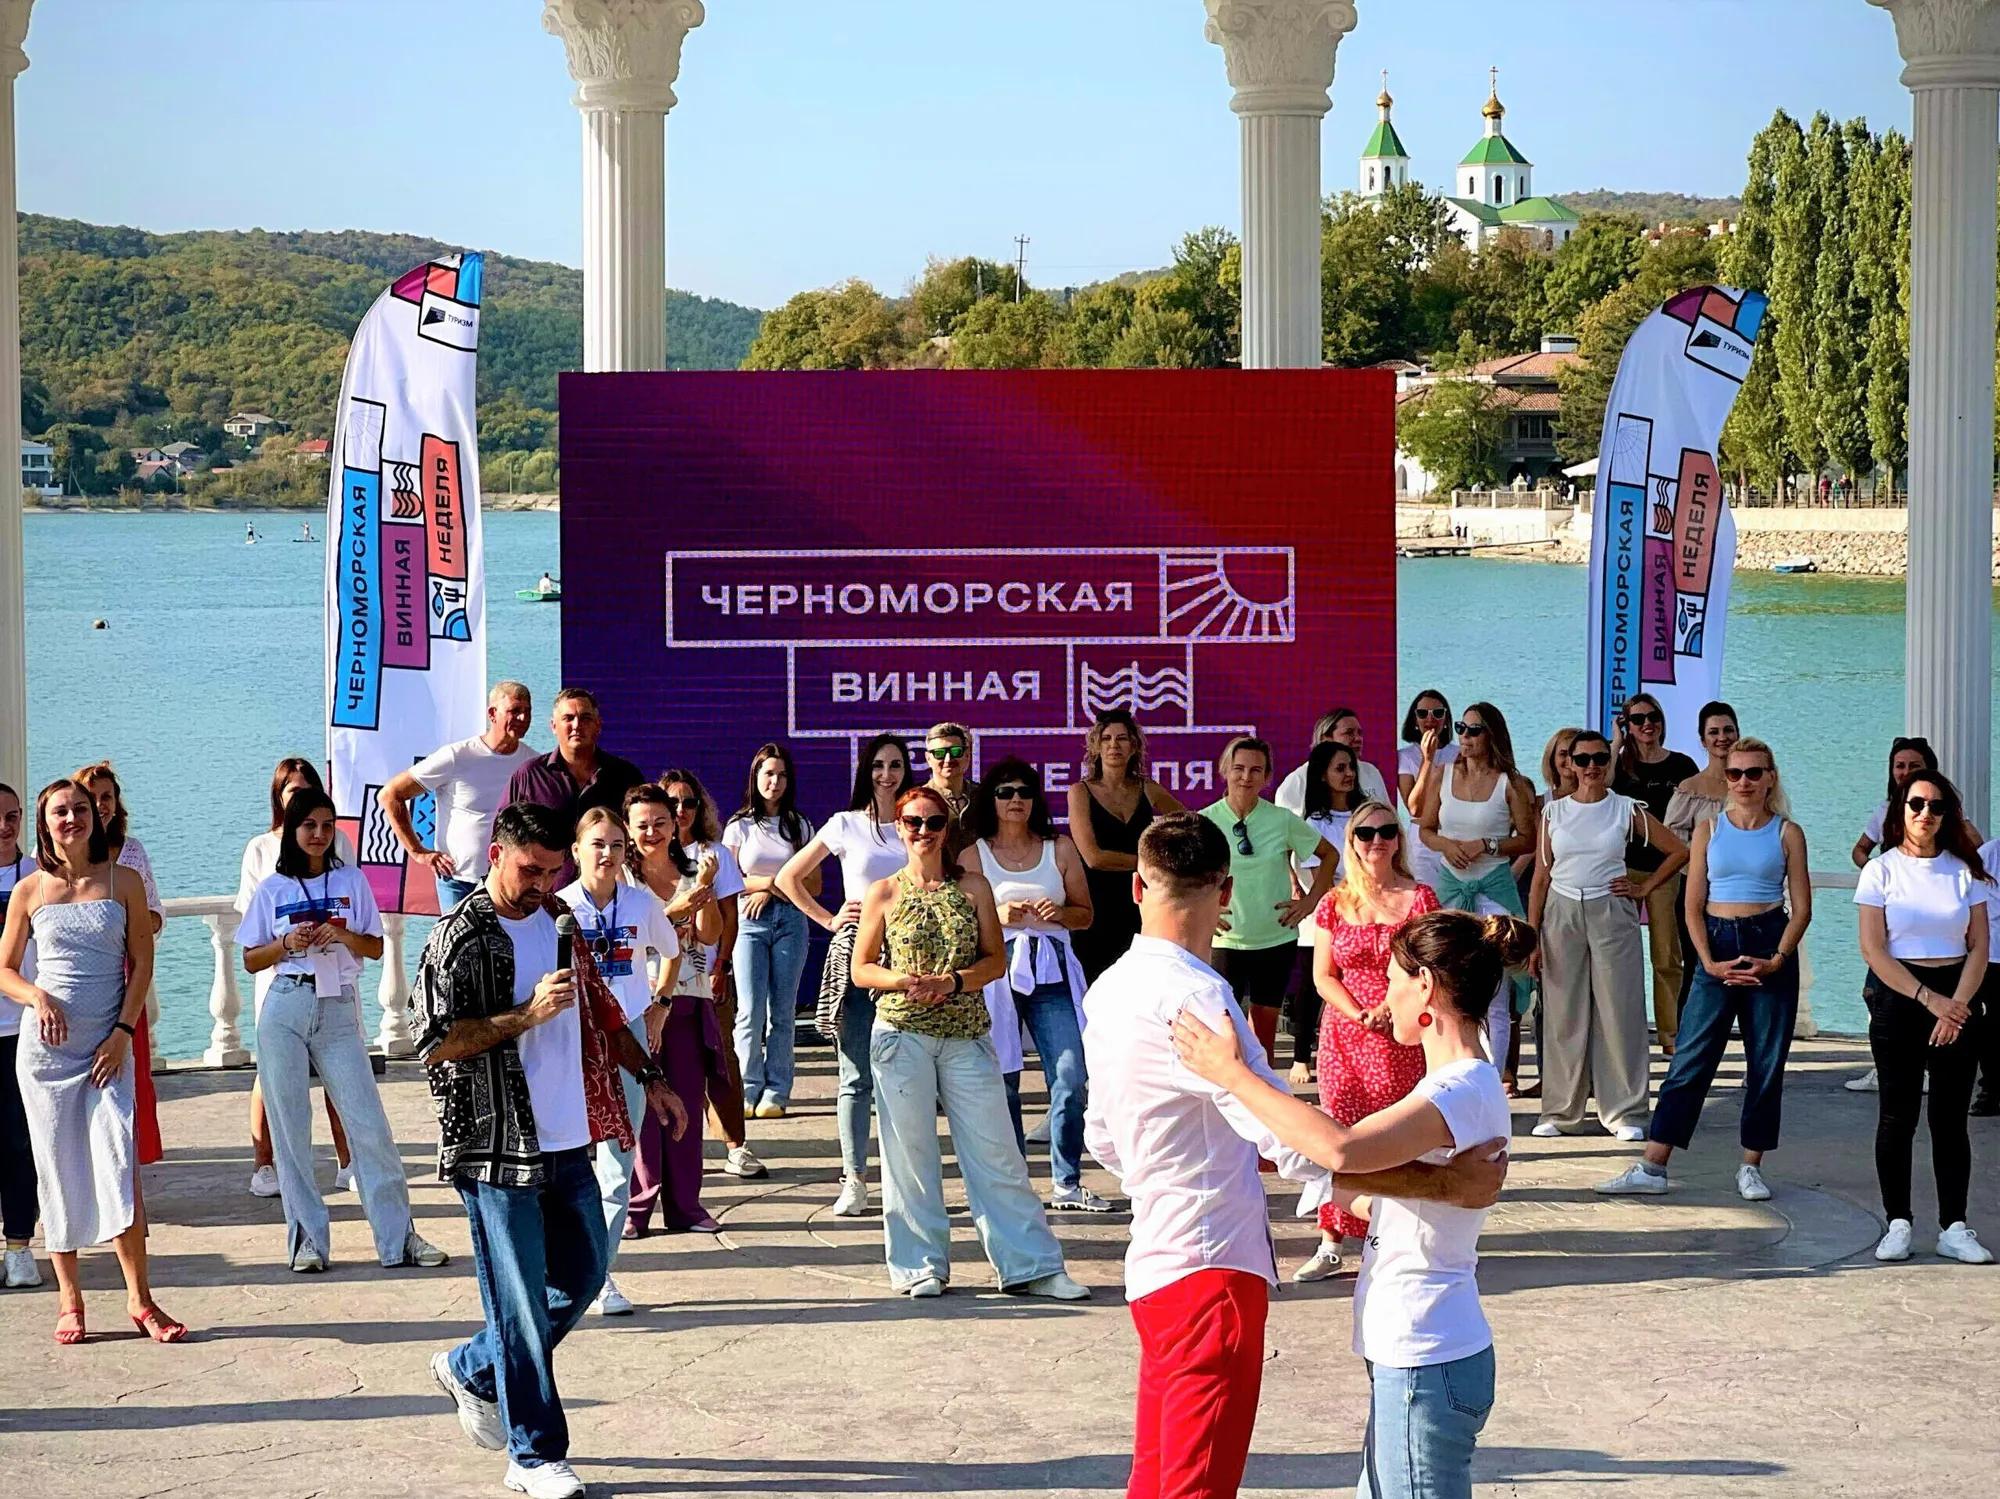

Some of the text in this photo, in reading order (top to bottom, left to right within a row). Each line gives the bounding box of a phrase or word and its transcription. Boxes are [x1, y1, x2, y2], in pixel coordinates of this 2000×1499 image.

[448, 314, 473, 328] ТУРИЗМ
[1723, 341, 1750, 360] ТУРИЗМ
[434, 458, 453, 564] НЕДЕЛЯ
[1683, 473, 1710, 578] НЕДЕЛЯ
[347, 486, 367, 710] ЧЕРНОМОРСКАЯ
[395, 540, 413, 646] ВИННАЯ
[701, 582, 1134, 616] ЧЕРНОМОРСКАЯ
[1653, 554, 1668, 662] ВИННАЯ
[831, 670, 1040, 703] ВИННАЯ
[1029, 760, 1213, 792] ЕЛЯ
